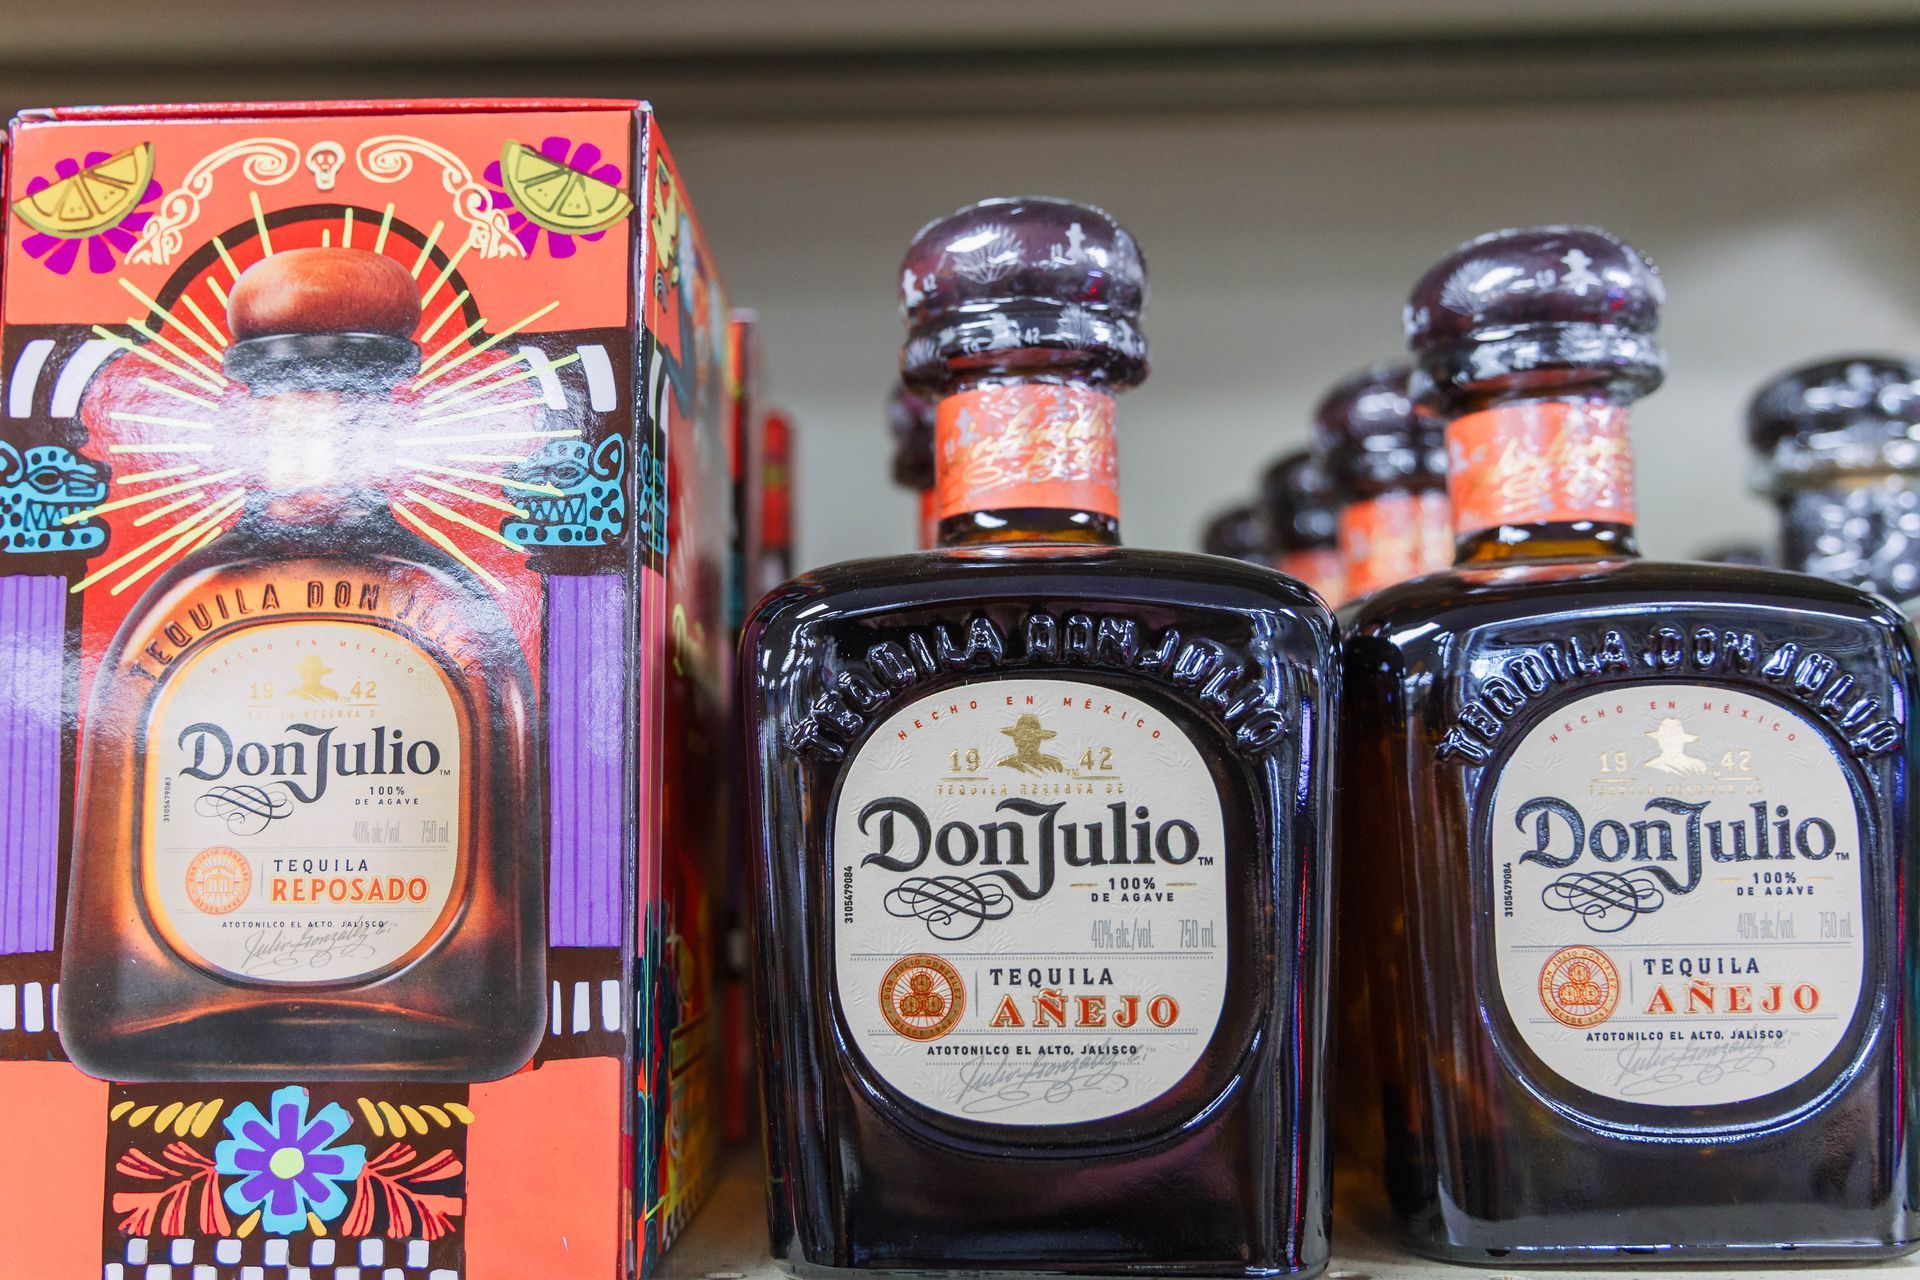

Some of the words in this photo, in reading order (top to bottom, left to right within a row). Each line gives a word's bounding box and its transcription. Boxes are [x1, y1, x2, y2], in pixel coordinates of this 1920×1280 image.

[129, 583, 281, 683] TEQUILA
[307, 580, 381, 611] DON
[1026, 613, 1136, 666] DON
[211, 643, 273, 675] HECHO
[295, 639, 317, 648] EN
[249, 681, 274, 700] 19
[350, 680, 377, 699] 42
[1435, 630, 1632, 765] TEQUILA
[1655, 627, 1758, 674] DON
[1761, 642, 1902, 756] JULIO
[897, 700, 978, 742] HECHO
[1006, 695, 1035, 705] EN
[1062, 696, 1162, 741] MÉXICO
[1549, 704, 1624, 744] HECHO
[1650, 702, 1676, 710] EN
[948, 748, 982, 773] 19
[1078, 746, 1114, 772] 42
[1600, 751, 1629, 773] 19
[1720, 750, 1752, 772] 42
[355, 797, 369, 806] DE
[378, 797, 420, 806] AGAVE
[369, 785, 405, 796] 100%
[936, 784, 1008, 796] TEQUILA
[1020, 783, 1094, 796] RESERVA
[421, 820, 437, 844] 750
[274, 859, 369, 874] TEQUILA
[1753, 872, 1797, 885] 100%
[271, 875, 430, 904] REPOSADO
[844, 865, 853, 924] 3105479084
[1108, 877, 1156, 890] 100%
[1504, 861, 1513, 918] 3105479084
[1737, 886, 1754, 896] DE
[1765, 886, 1814, 896] AGAVE
[1091, 892, 1110, 902] DE
[1121, 892, 1175, 902] AGAVE
[221, 920, 286, 929] ATOTONILCO
[291, 920, 302, 929] EL
[340, 920, 384, 929] JALISCO
[1091, 919, 1114, 949] 40%
[1178, 919, 1199, 949] 750
[1819, 911, 1837, 938] 750
[990, 967, 1114, 988] TEQUILA
[1643, 957, 1760, 978] TEQUILA
[989, 988, 1180, 1028] AÑEJO
[1643, 977, 1821, 1015] AÑEJO
[1586, 1031, 1664, 1042] ATOTONILCO
[1670, 1031, 1685, 1041] EL
[1730, 1030, 1784, 1040] JALISCO
[927, 1045, 1009, 1056] ATOTONILCO
[1016, 1045, 1032, 1056] EL
[1039, 1045, 1074, 1057] ALTO,
[1080, 1045, 1138, 1056] JALISCO
